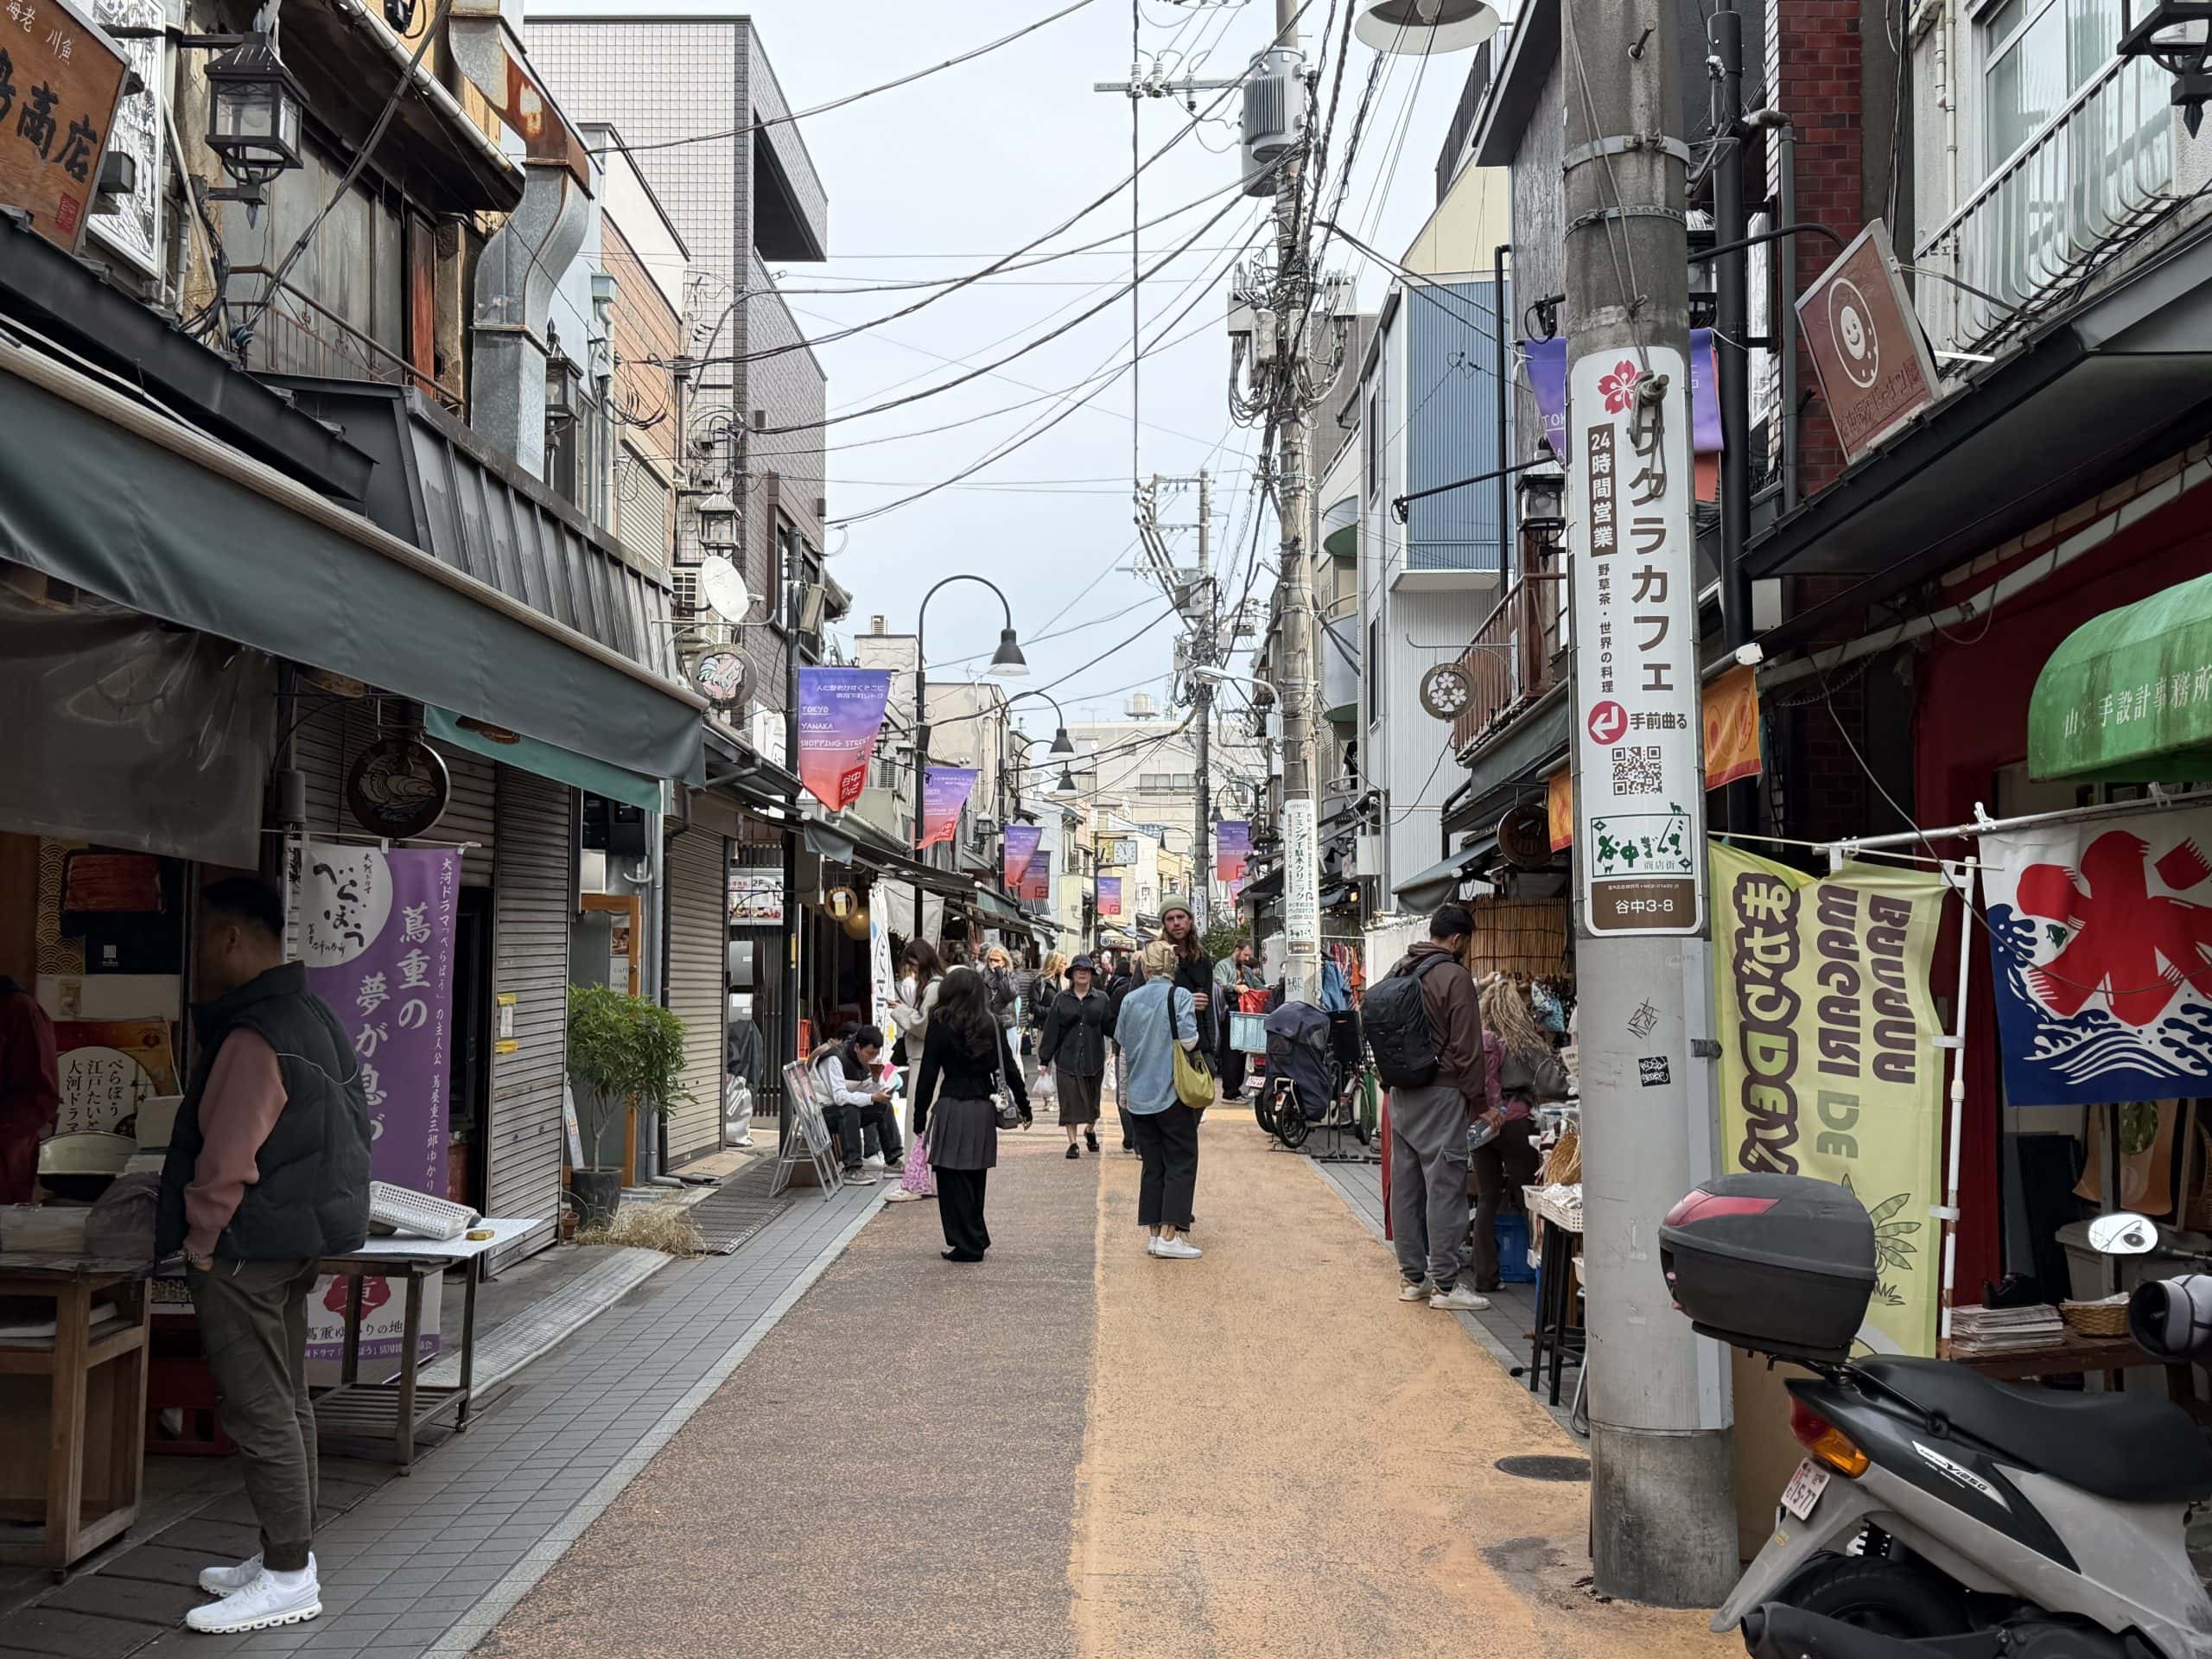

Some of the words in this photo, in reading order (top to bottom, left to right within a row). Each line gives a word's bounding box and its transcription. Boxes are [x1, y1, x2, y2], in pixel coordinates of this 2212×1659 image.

[47, 29, 72, 66] 川魚
[1591, 431, 1614, 548] 24時間営業
[1598, 563, 1614, 693] 野草茶・世界の料理
[802, 705, 830, 714] TOKYO
[2064, 664, 2212, 740] 山手設計事務所
[1630, 712, 1688, 730] 手前曲る
[800, 739, 842, 748] SHOPPING
[845, 734, 872, 747] STREET
[1614, 899, 1675, 914] 谷中3-8
[396, 901, 431, 1030] 蔦重の
[306, 1319, 403, 1341] 蔦重ゆりの地
